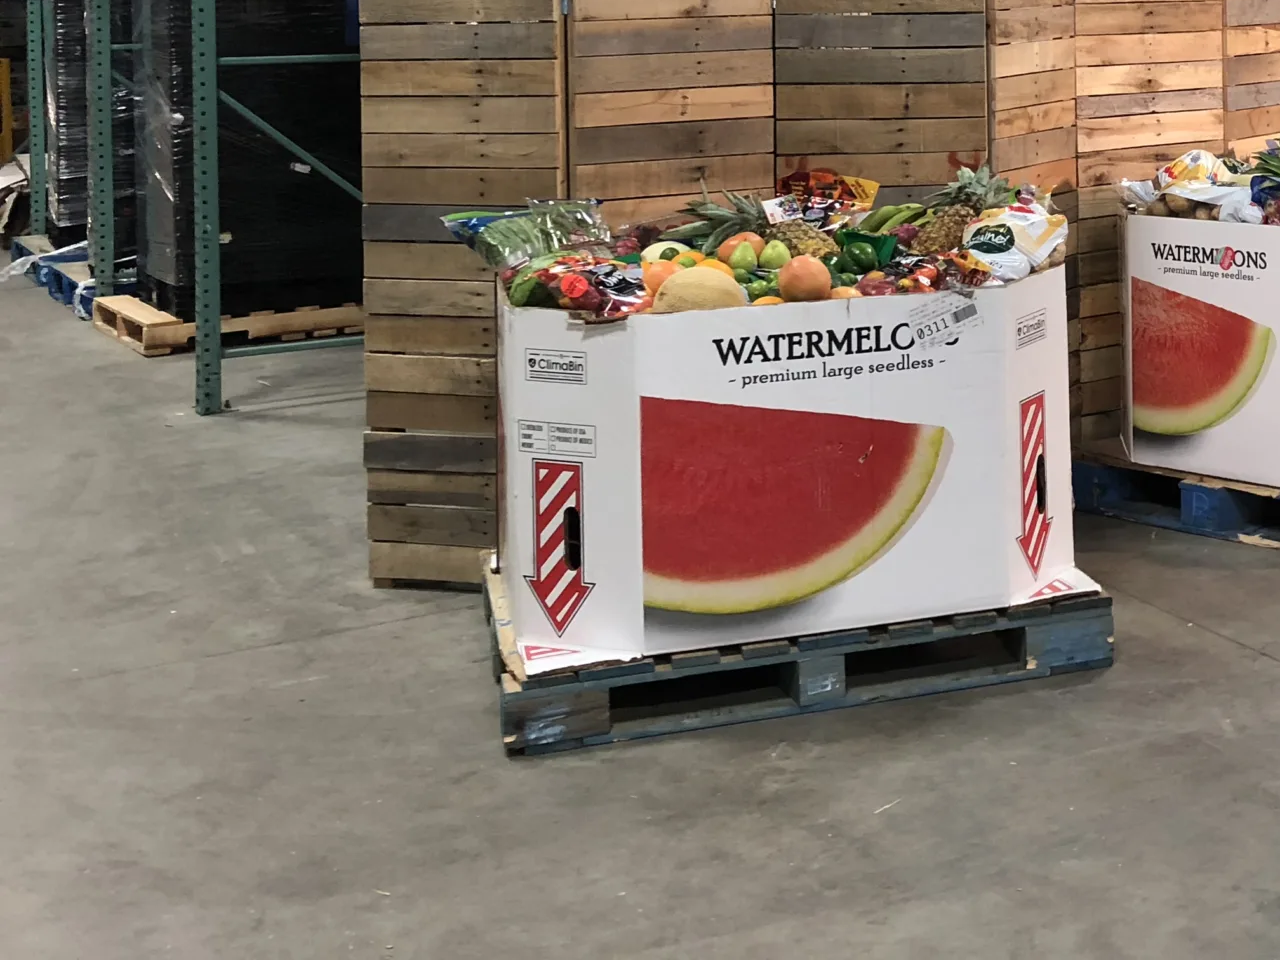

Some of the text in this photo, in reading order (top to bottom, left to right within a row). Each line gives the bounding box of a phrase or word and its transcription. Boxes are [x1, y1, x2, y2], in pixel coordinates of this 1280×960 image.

[1151, 242, 1268, 270] WATERMONS
[1163, 266, 1254, 281] premium large seedless
[916, 317, 950, 340] 0311
[712, 323, 960, 367] WATERMELO
[538, 358, 584, 372] ClimaBin
[741, 353, 934, 389] premium large seedless
